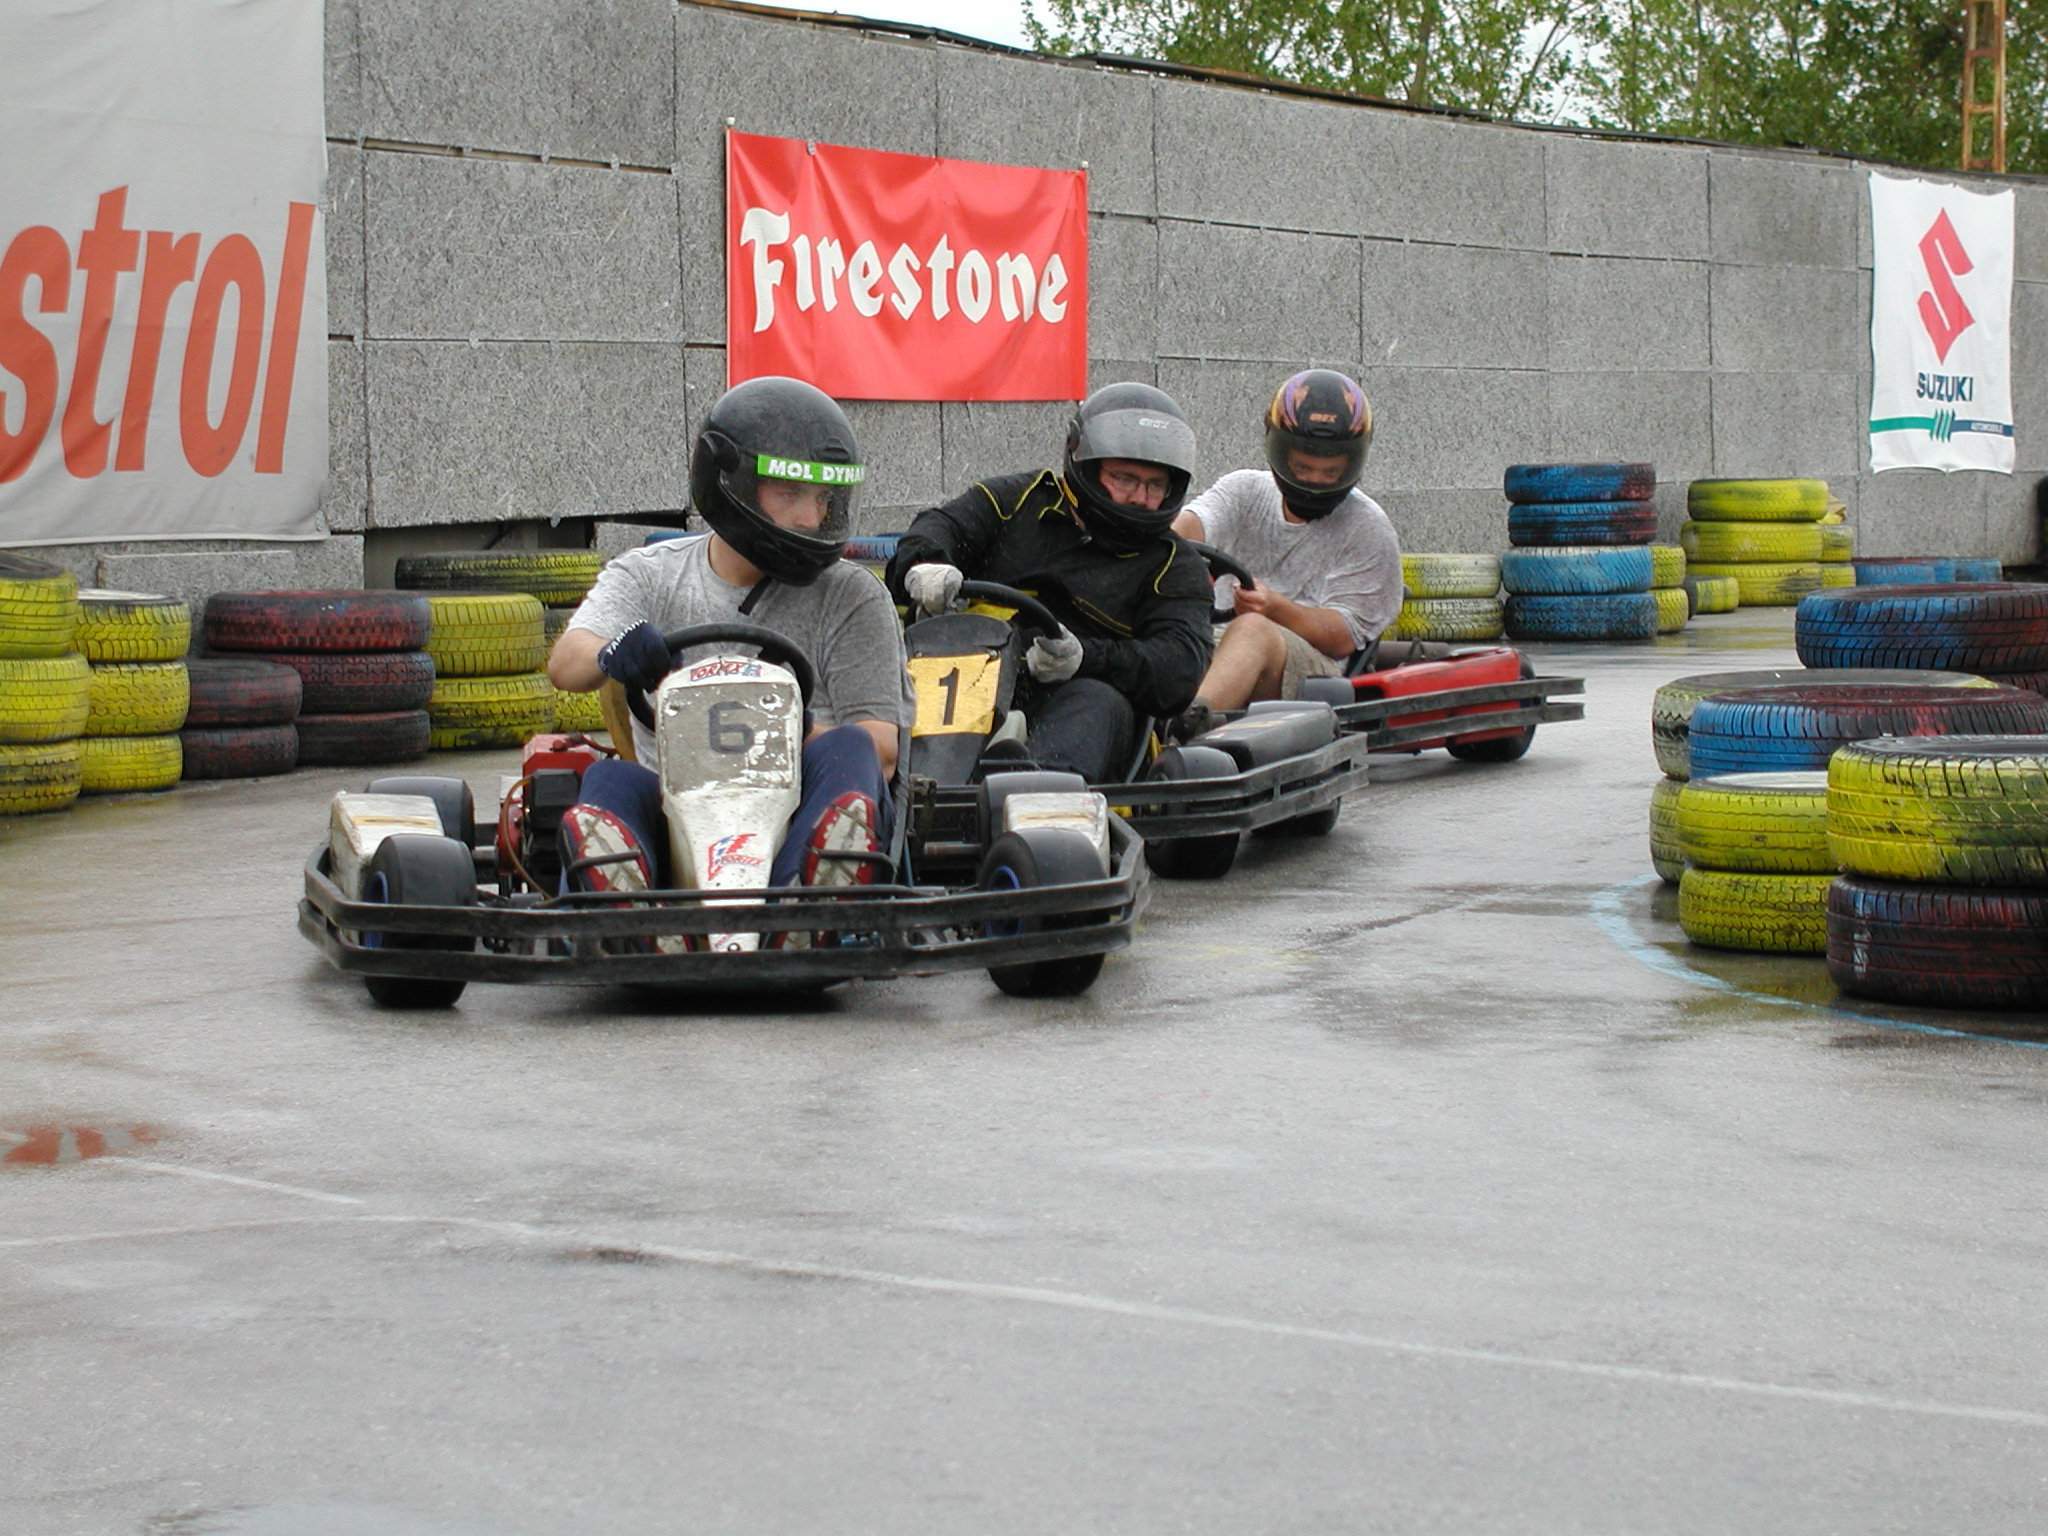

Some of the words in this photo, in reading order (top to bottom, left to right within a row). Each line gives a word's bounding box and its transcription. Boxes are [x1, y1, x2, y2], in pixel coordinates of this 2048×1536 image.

[740, 207, 1068, 333] Firestone
[1916, 372, 1973, 402] SUZUKI
[768, 459, 813, 480] MOL
[939, 667, 960, 726] 1
[708, 701, 753, 754] 6
